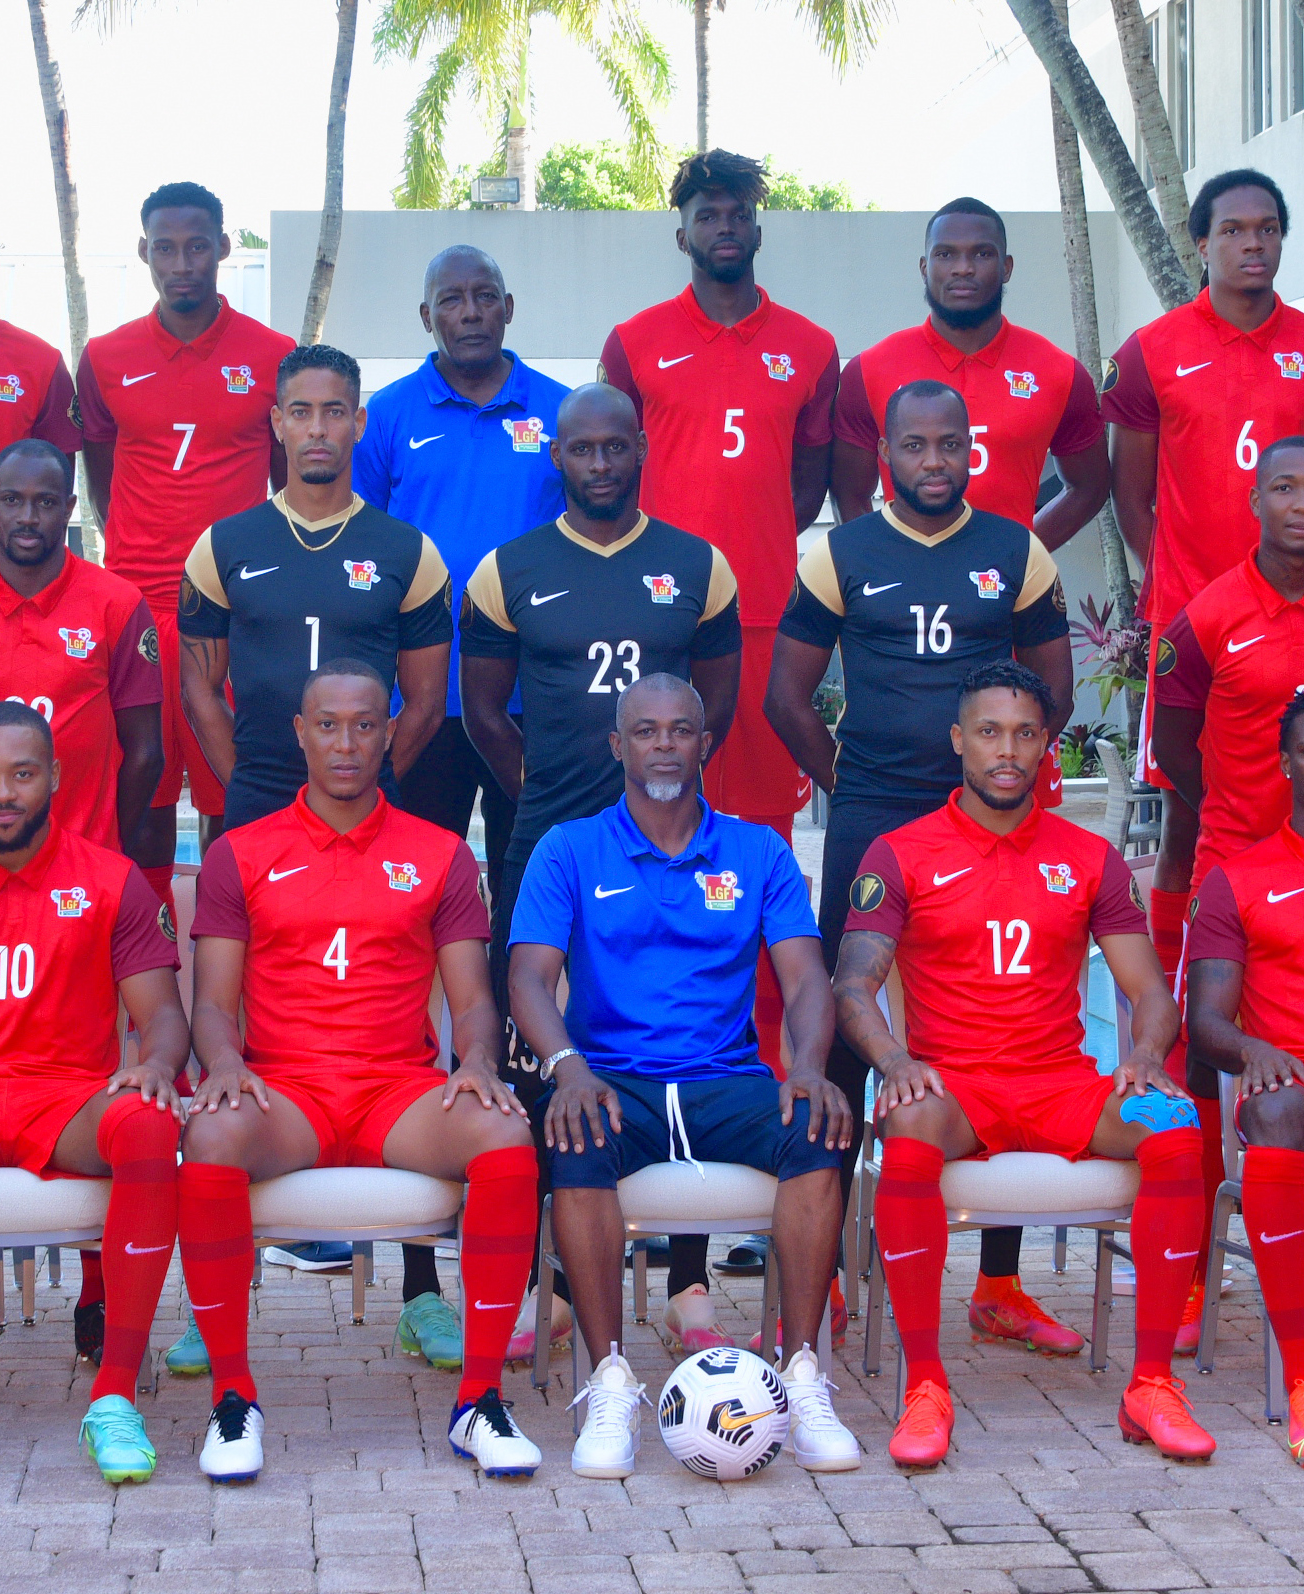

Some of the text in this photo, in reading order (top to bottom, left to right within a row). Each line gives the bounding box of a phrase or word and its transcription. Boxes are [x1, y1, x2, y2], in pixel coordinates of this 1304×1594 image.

[771, 365, 786, 373] LGF
[1284, 362, 1298, 371] LGF
[230, 376, 246, 385] LGF
[1013, 381, 1029, 390] LGF
[0, 384, 14, 394] LGF
[515, 431, 536, 443] LGF
[722, 408, 745, 458] 5
[172, 423, 196, 471] 7
[1235, 420, 1259, 471] 6
[353, 570, 369, 581] LGF
[654, 585, 669, 594] LGF
[981, 581, 995, 590] LGF
[909, 604, 952, 655] 16
[69, 639, 84, 649] LGF
[305, 616, 320, 671] 1
[587, 639, 641, 694] 23
[393, 872, 410, 882] LGF
[1050, 876, 1065, 885] LGF
[708, 886, 729, 899] LGF
[62, 900, 77, 909] LGF
[986, 918, 1031, 975] 12
[322, 927, 350, 980] 4
